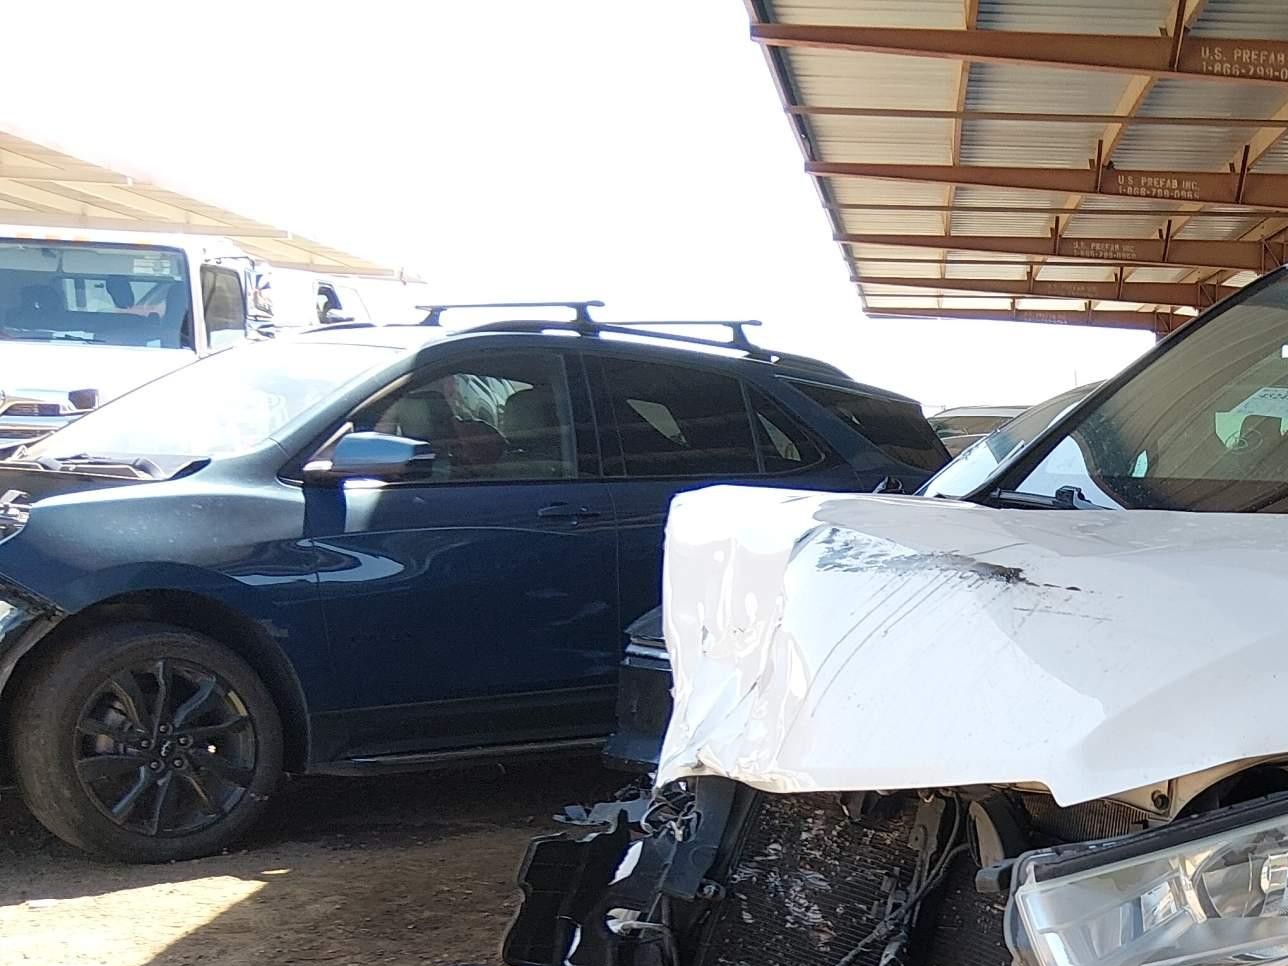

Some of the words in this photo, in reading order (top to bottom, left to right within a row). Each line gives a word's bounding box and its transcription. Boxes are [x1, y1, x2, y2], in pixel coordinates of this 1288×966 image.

[1200, 46, 1227, 61] U.S.
[1233, 48, 1286, 66] PREFAB
[1140, 176, 1179, 189] PREFAB
